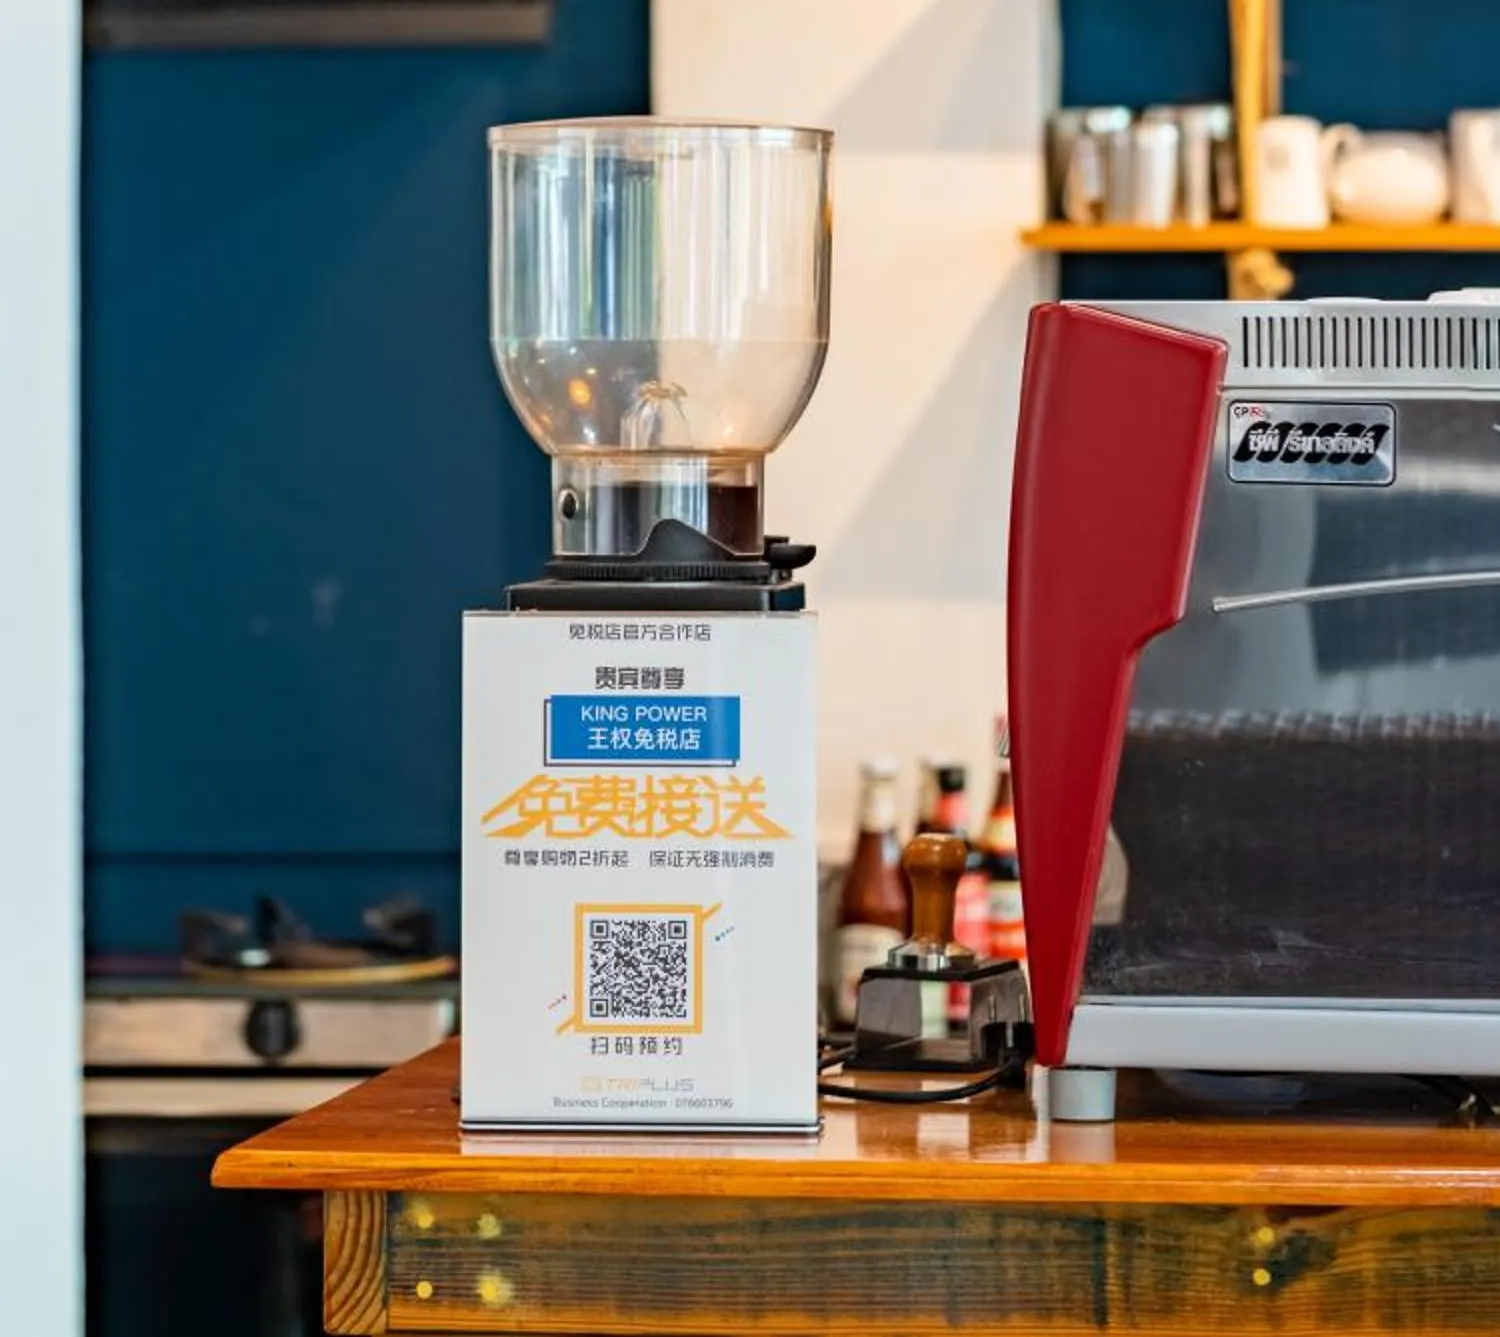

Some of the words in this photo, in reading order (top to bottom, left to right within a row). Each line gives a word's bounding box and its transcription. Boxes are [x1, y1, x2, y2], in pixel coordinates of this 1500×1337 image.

[569, 623, 712, 641] 免税店官方合作店
[594, 666, 685, 689] 贵宾尊享
[581, 706, 629, 722] KING
[635, 706, 707, 722] POWER
[587, 727, 701, 750] 王权免税店
[480, 775, 796, 839] 免费接送
[590, 1036, 683, 1056] 扫码预约
